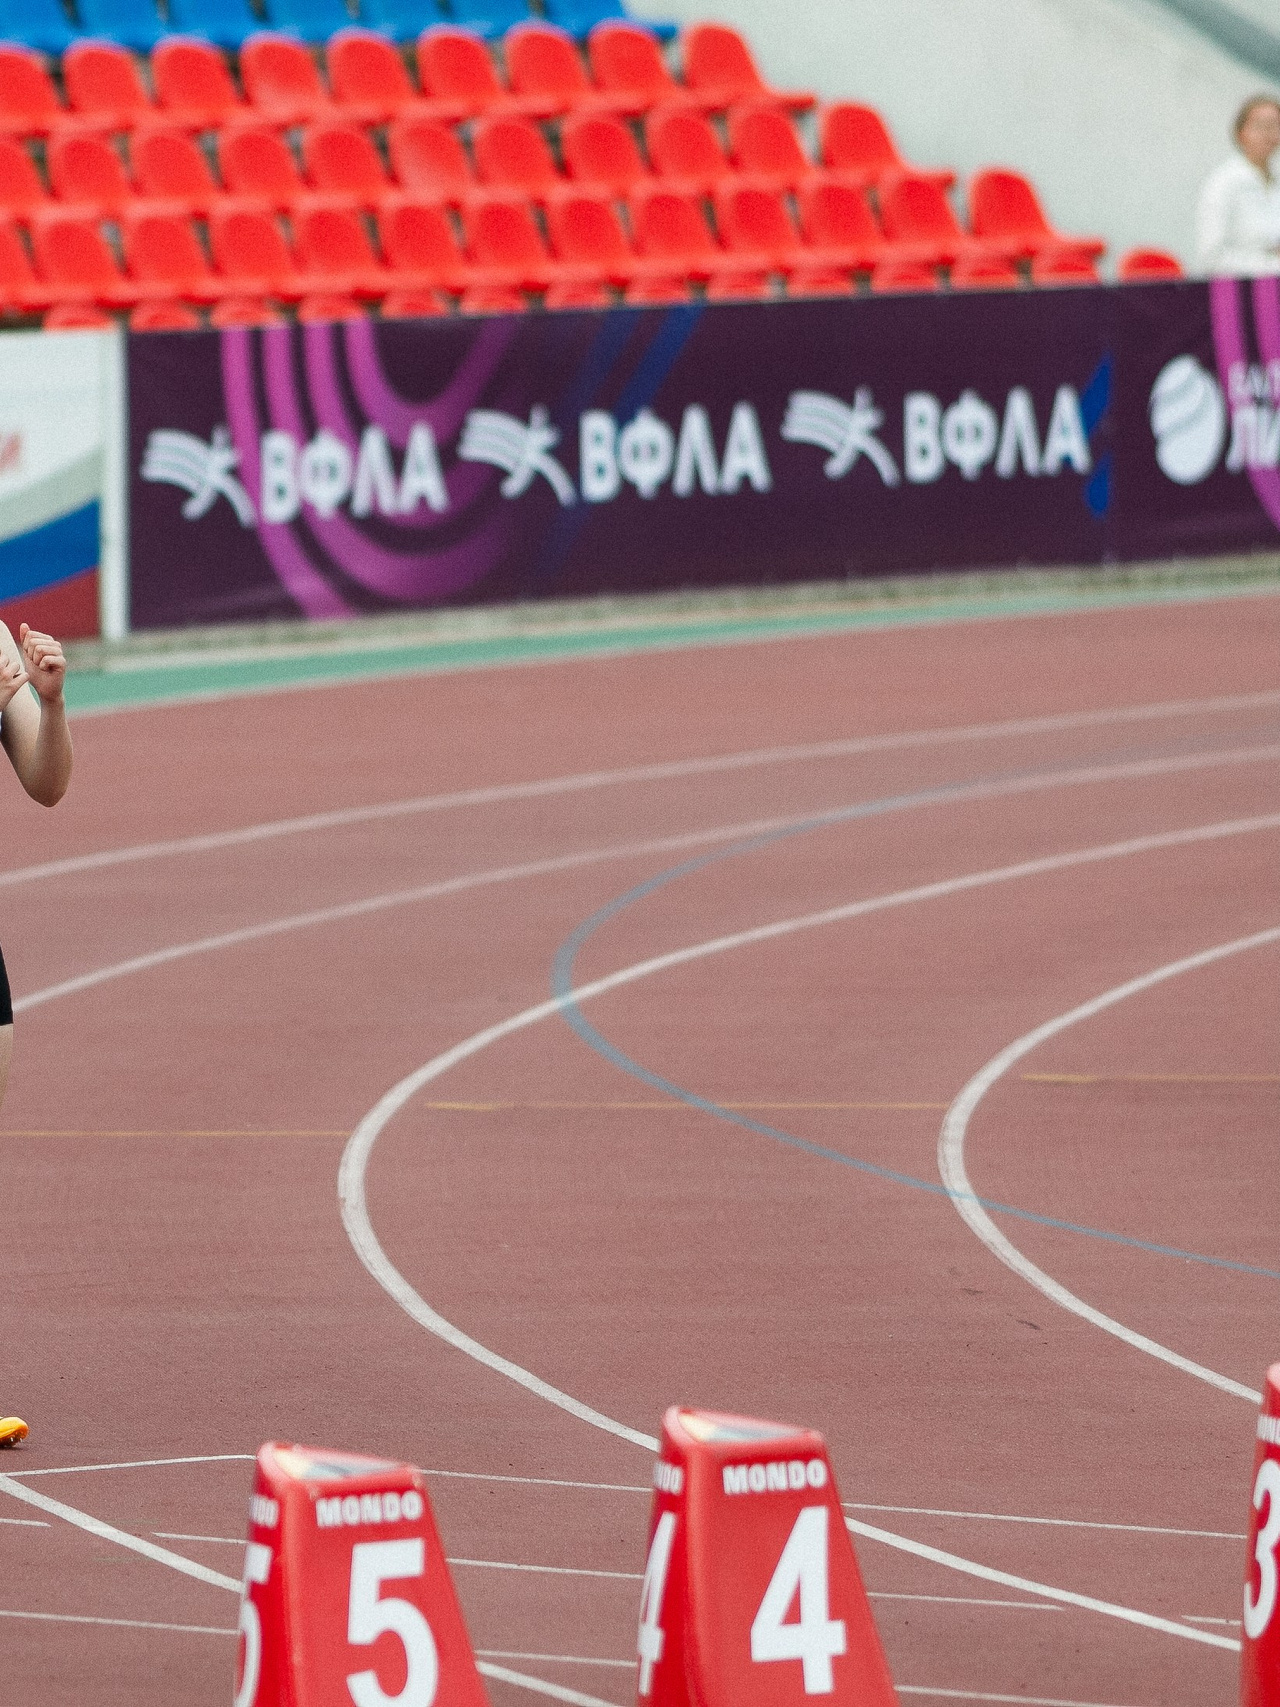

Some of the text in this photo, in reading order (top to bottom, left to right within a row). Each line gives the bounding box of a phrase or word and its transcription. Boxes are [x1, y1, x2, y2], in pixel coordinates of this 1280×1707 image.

[260, 422, 451, 525] ВФЛА
[578, 402, 773, 505] ВФЛА
[903, 384, 1092, 485] ВФЛА
[315, 1489, 423, 1530] MONDO
[722, 1458, 827, 1495] MONDO
[750, 1504, 846, 1695] 4
[1245, 1458, 1280, 1640] 3
[346, 1536, 439, 1707] 5
